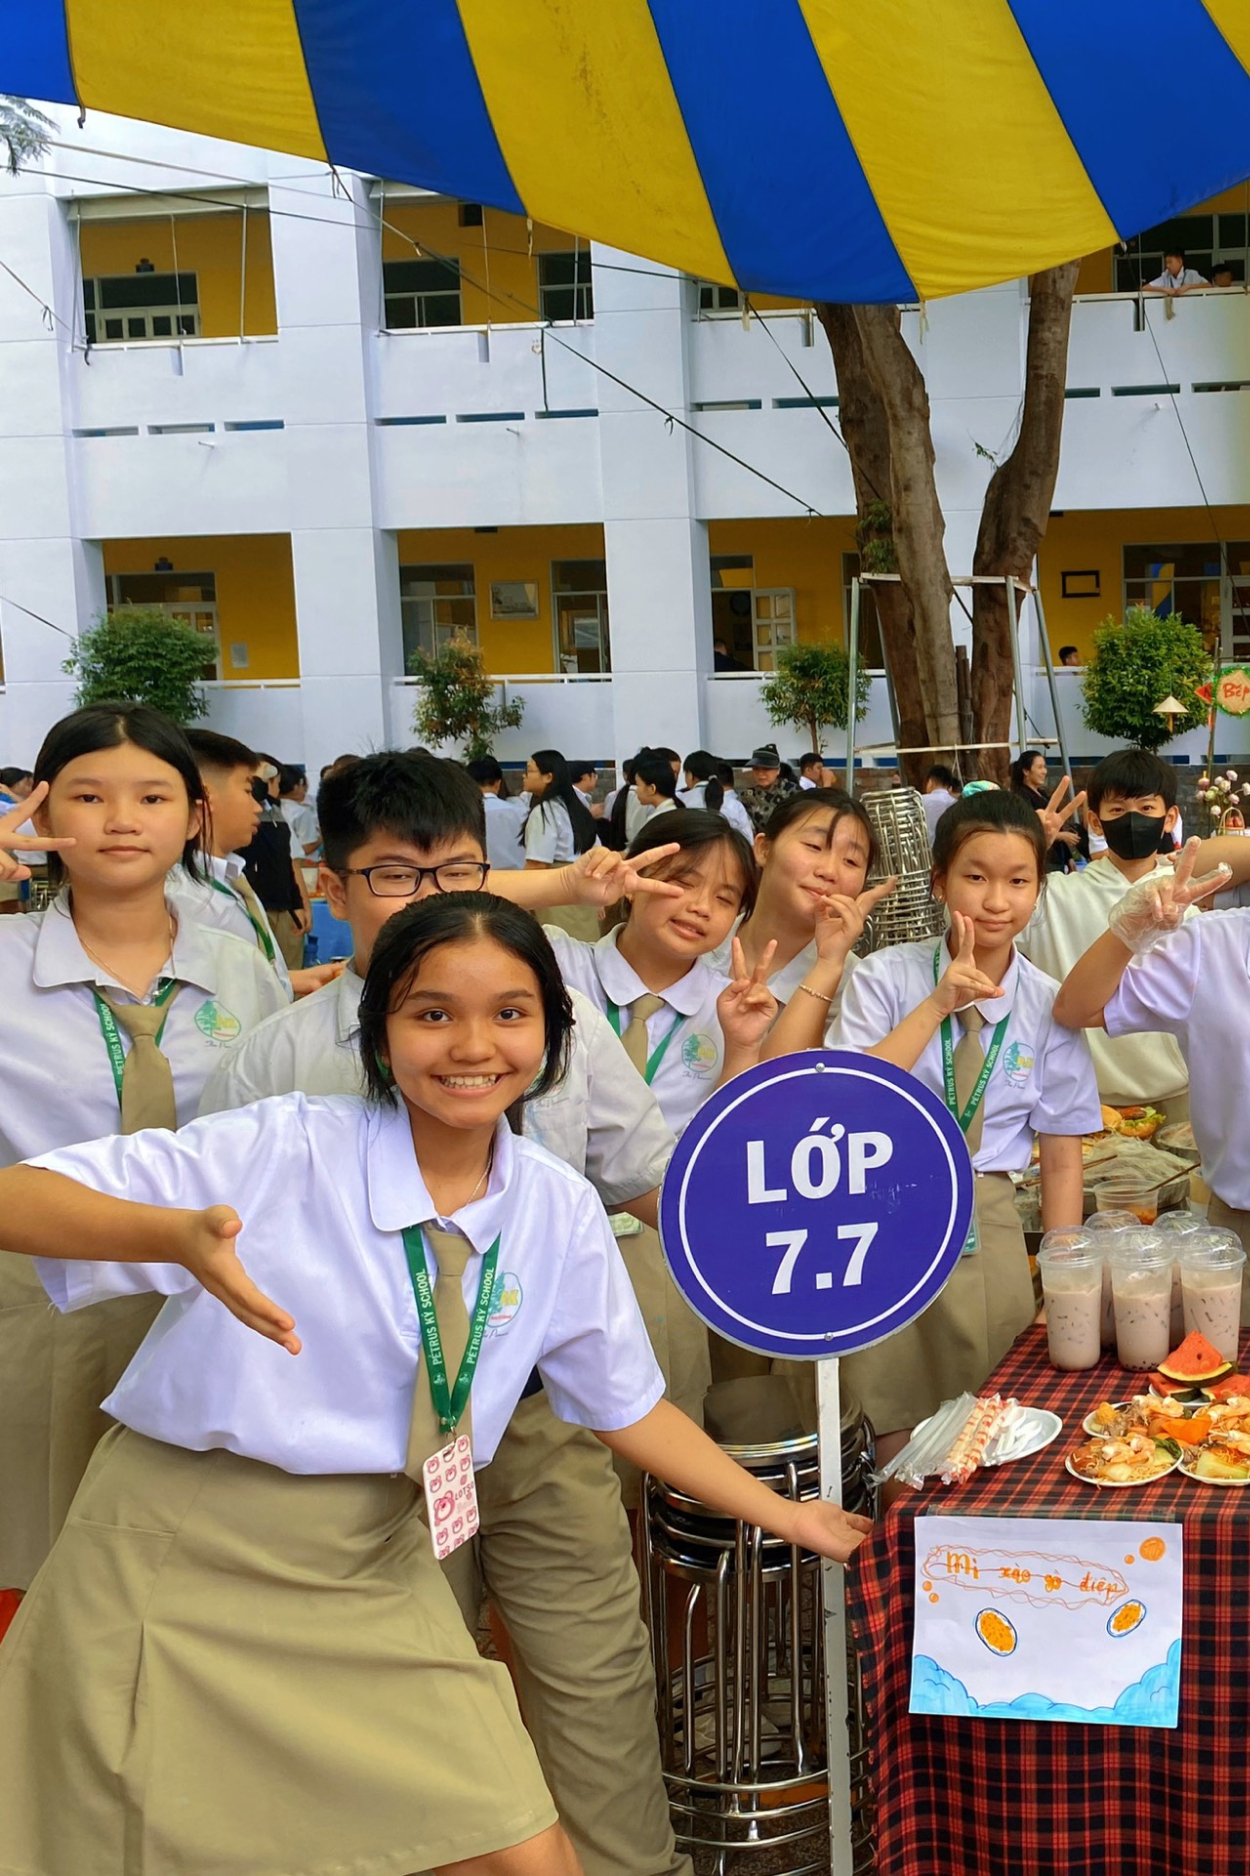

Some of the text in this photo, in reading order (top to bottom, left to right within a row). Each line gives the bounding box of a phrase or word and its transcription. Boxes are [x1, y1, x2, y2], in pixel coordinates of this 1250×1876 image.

[986, 1044, 1000, 1069] SCHOOL
[747, 1116, 893, 1204] LỚP
[766, 1222, 878, 1294] 7.7
[416, 1268, 442, 1366] PÉTRUS KÝ SCHOOL
[466, 1267, 494, 1365] PÉTRUS KÝ SCHOOL
